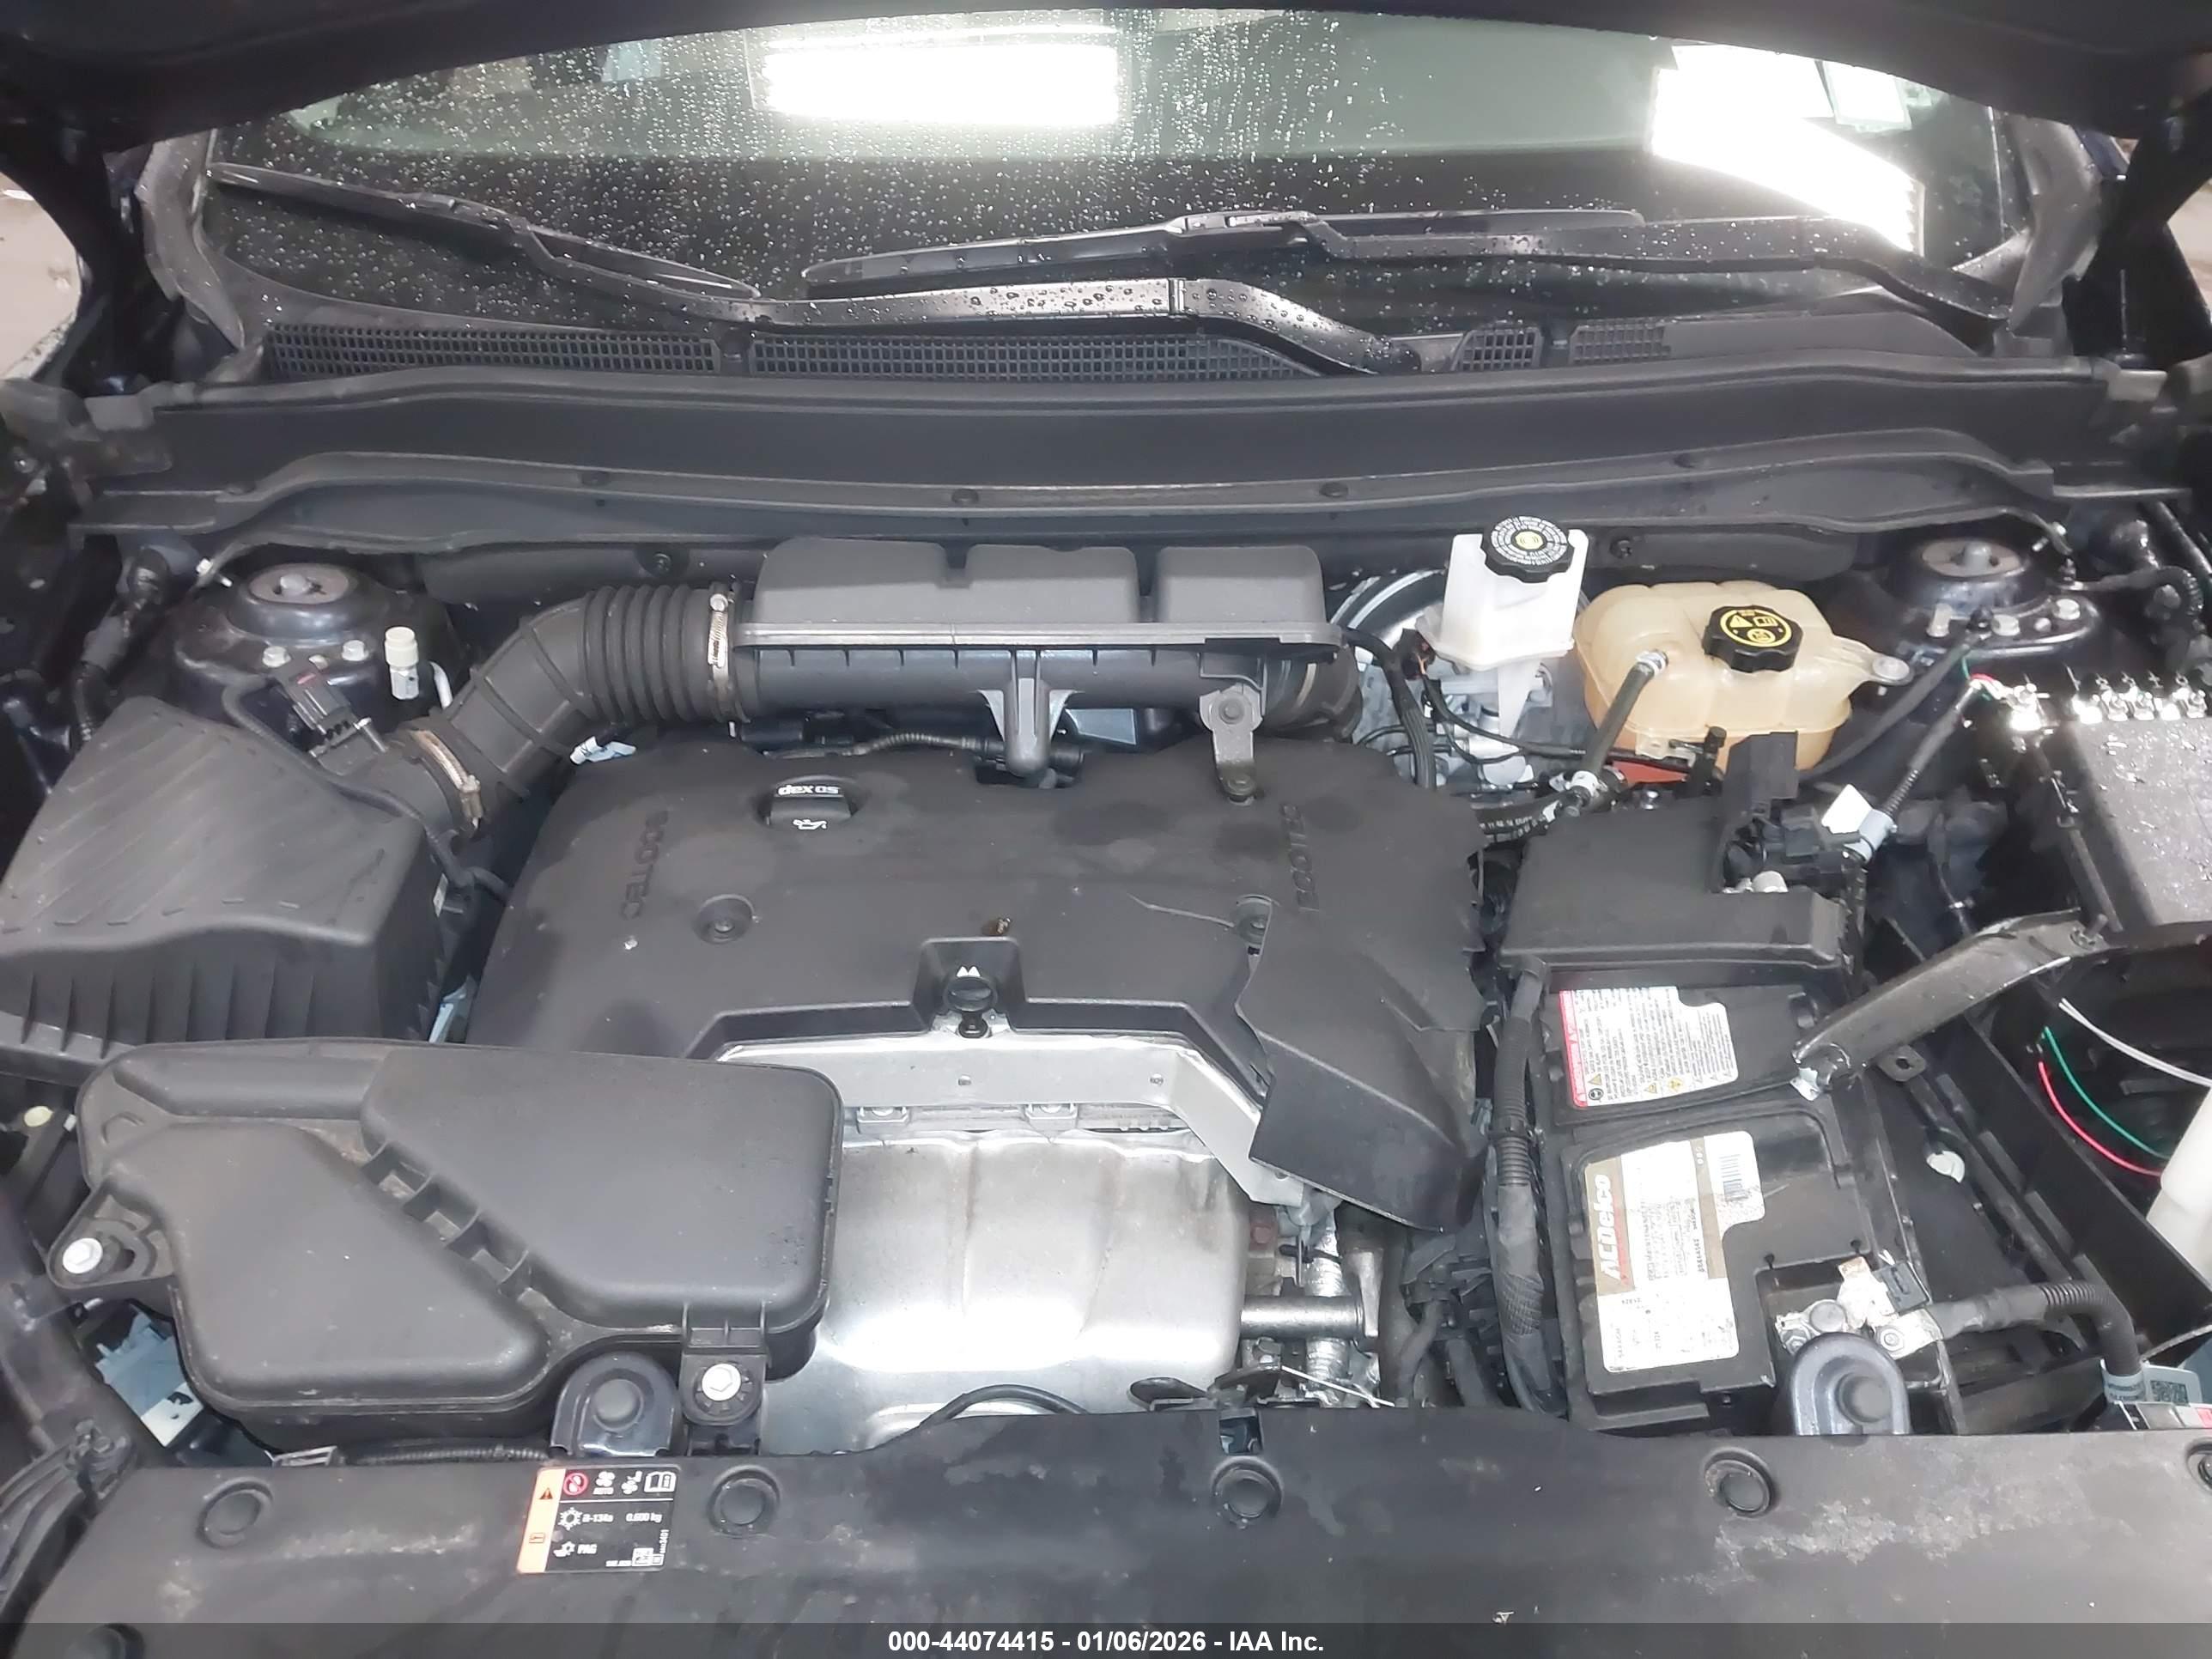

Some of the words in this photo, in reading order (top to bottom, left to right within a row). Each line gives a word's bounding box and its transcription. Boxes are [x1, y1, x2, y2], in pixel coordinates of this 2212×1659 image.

[777, 783, 840, 796] dexos
[621, 810, 668, 920] ECOTEC
[1595, 1173, 1622, 1280] ACDelco
